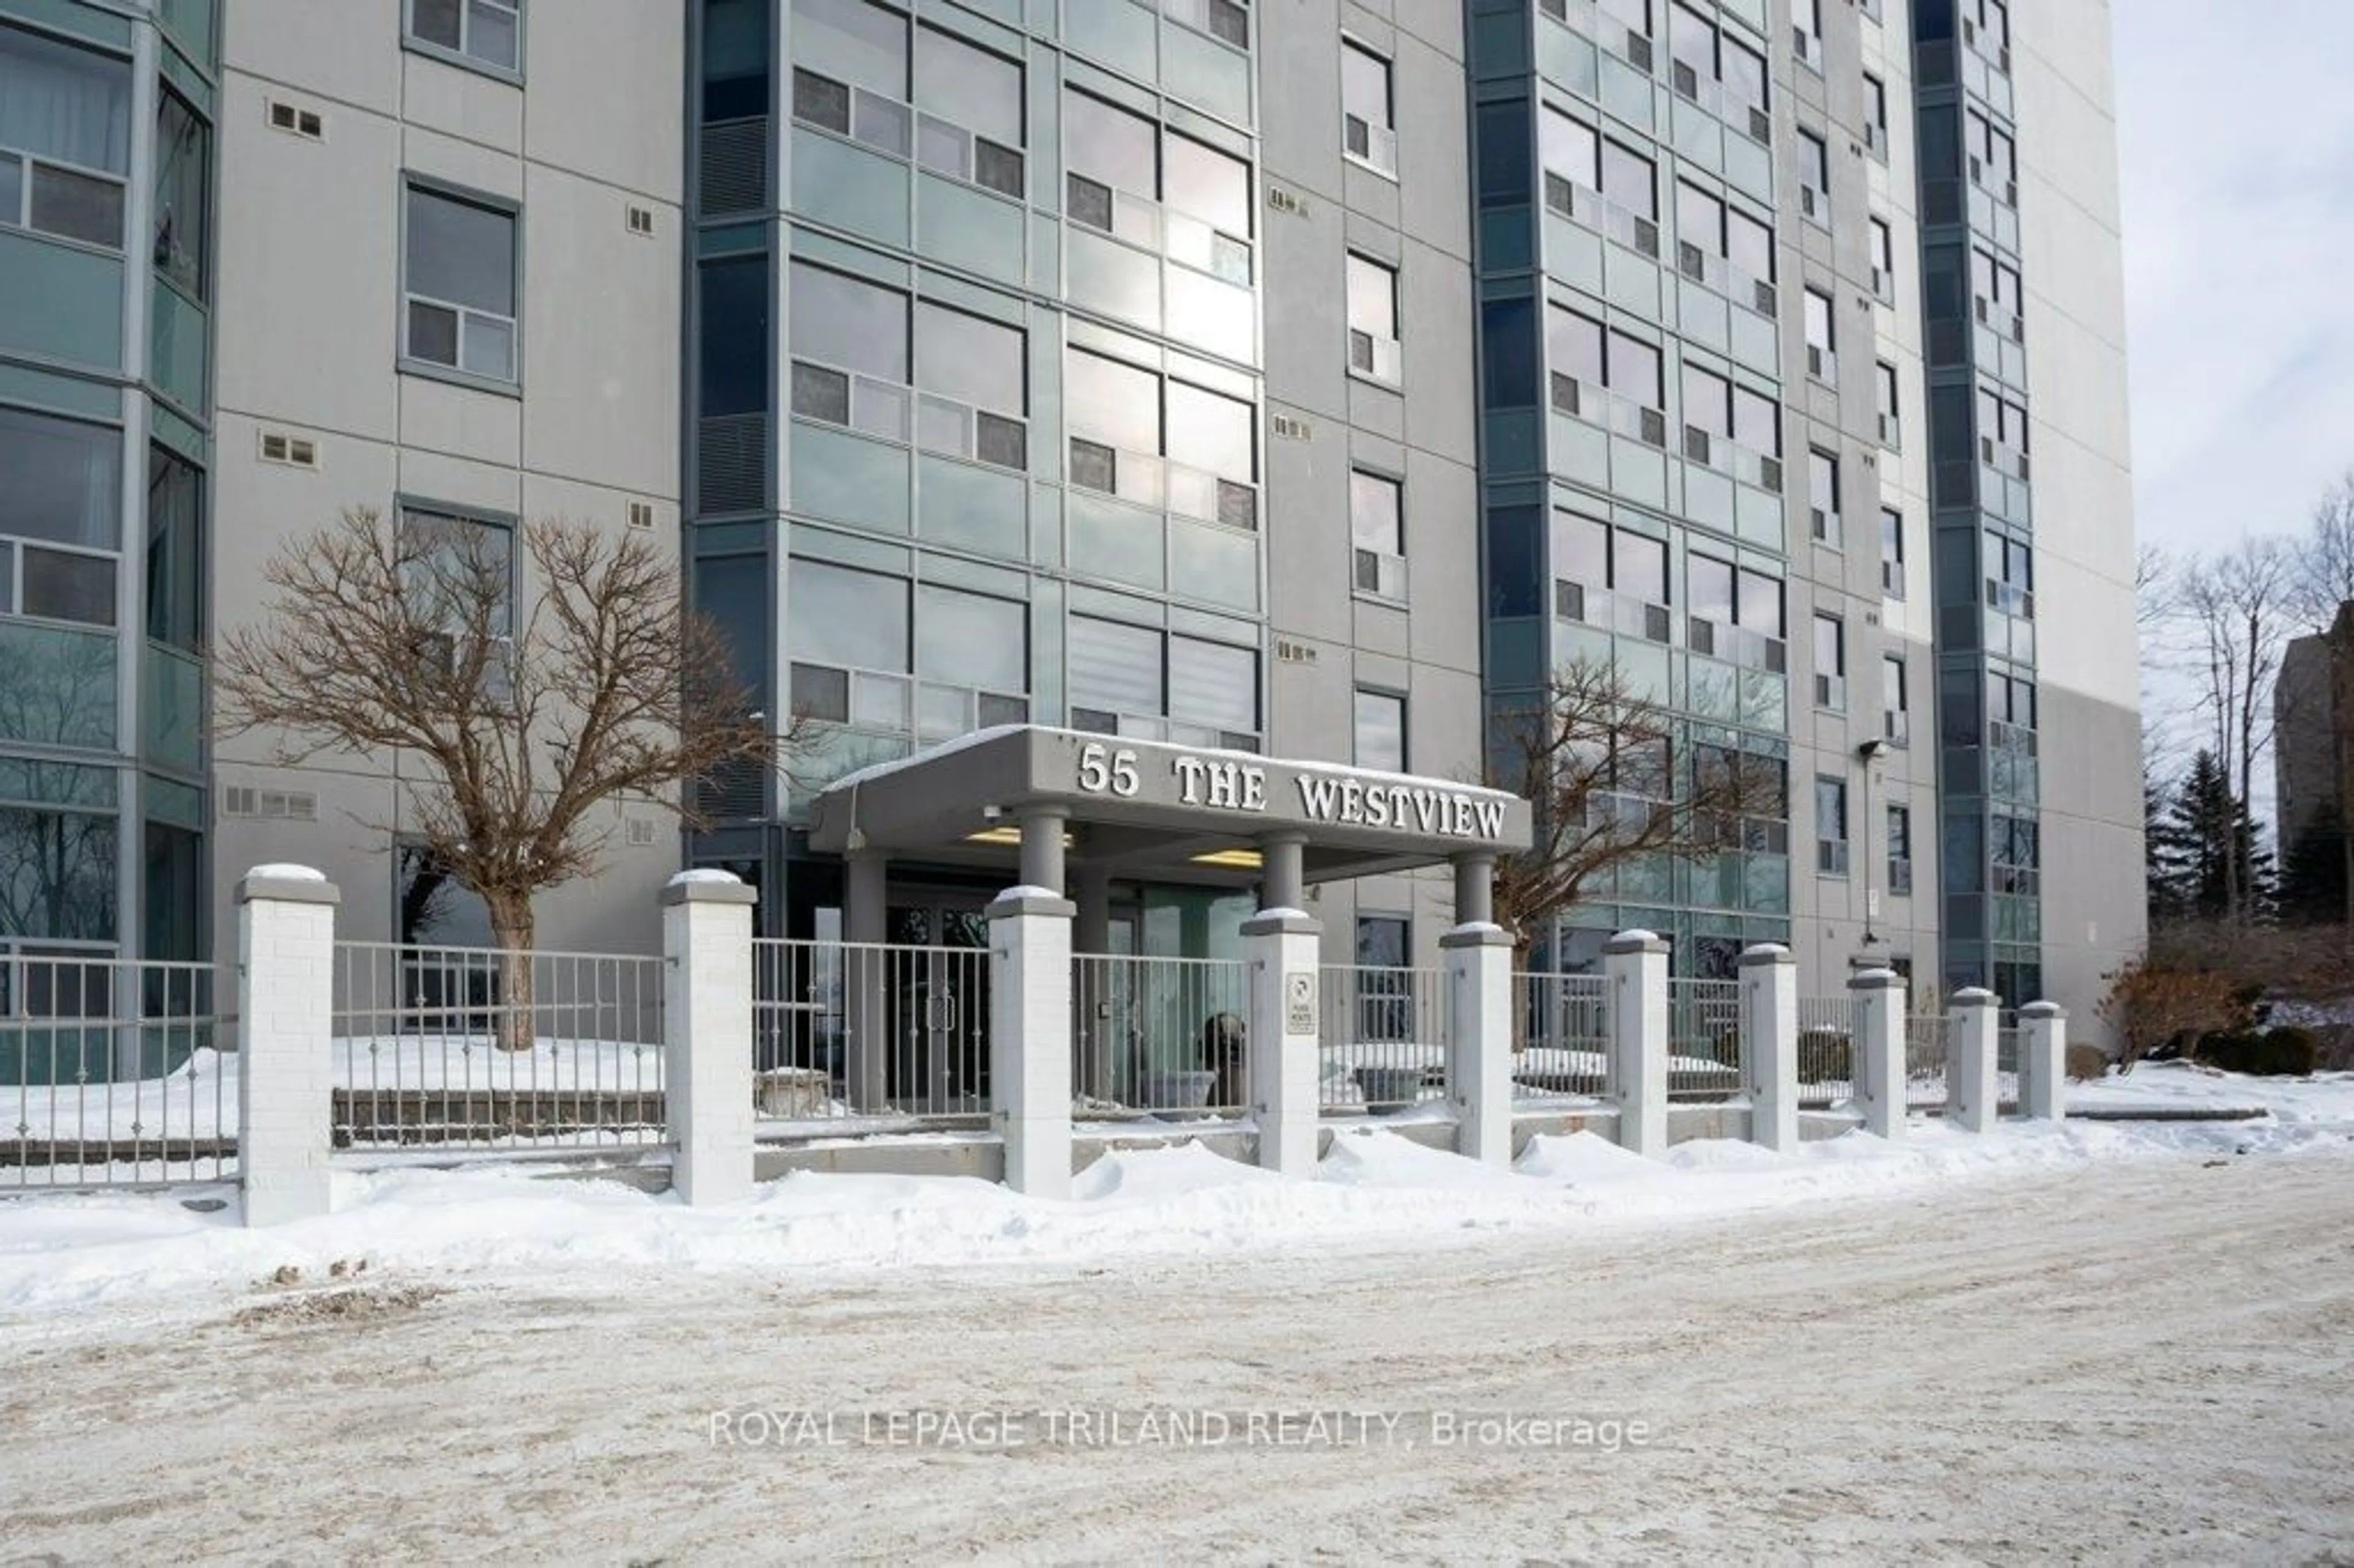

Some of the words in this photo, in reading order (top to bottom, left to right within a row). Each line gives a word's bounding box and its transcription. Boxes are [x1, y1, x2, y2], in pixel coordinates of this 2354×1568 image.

[1080, 743, 1140, 797] 55
[1174, 755, 1267, 812] THE
[1297, 774, 1507, 839] WESTVIEW
